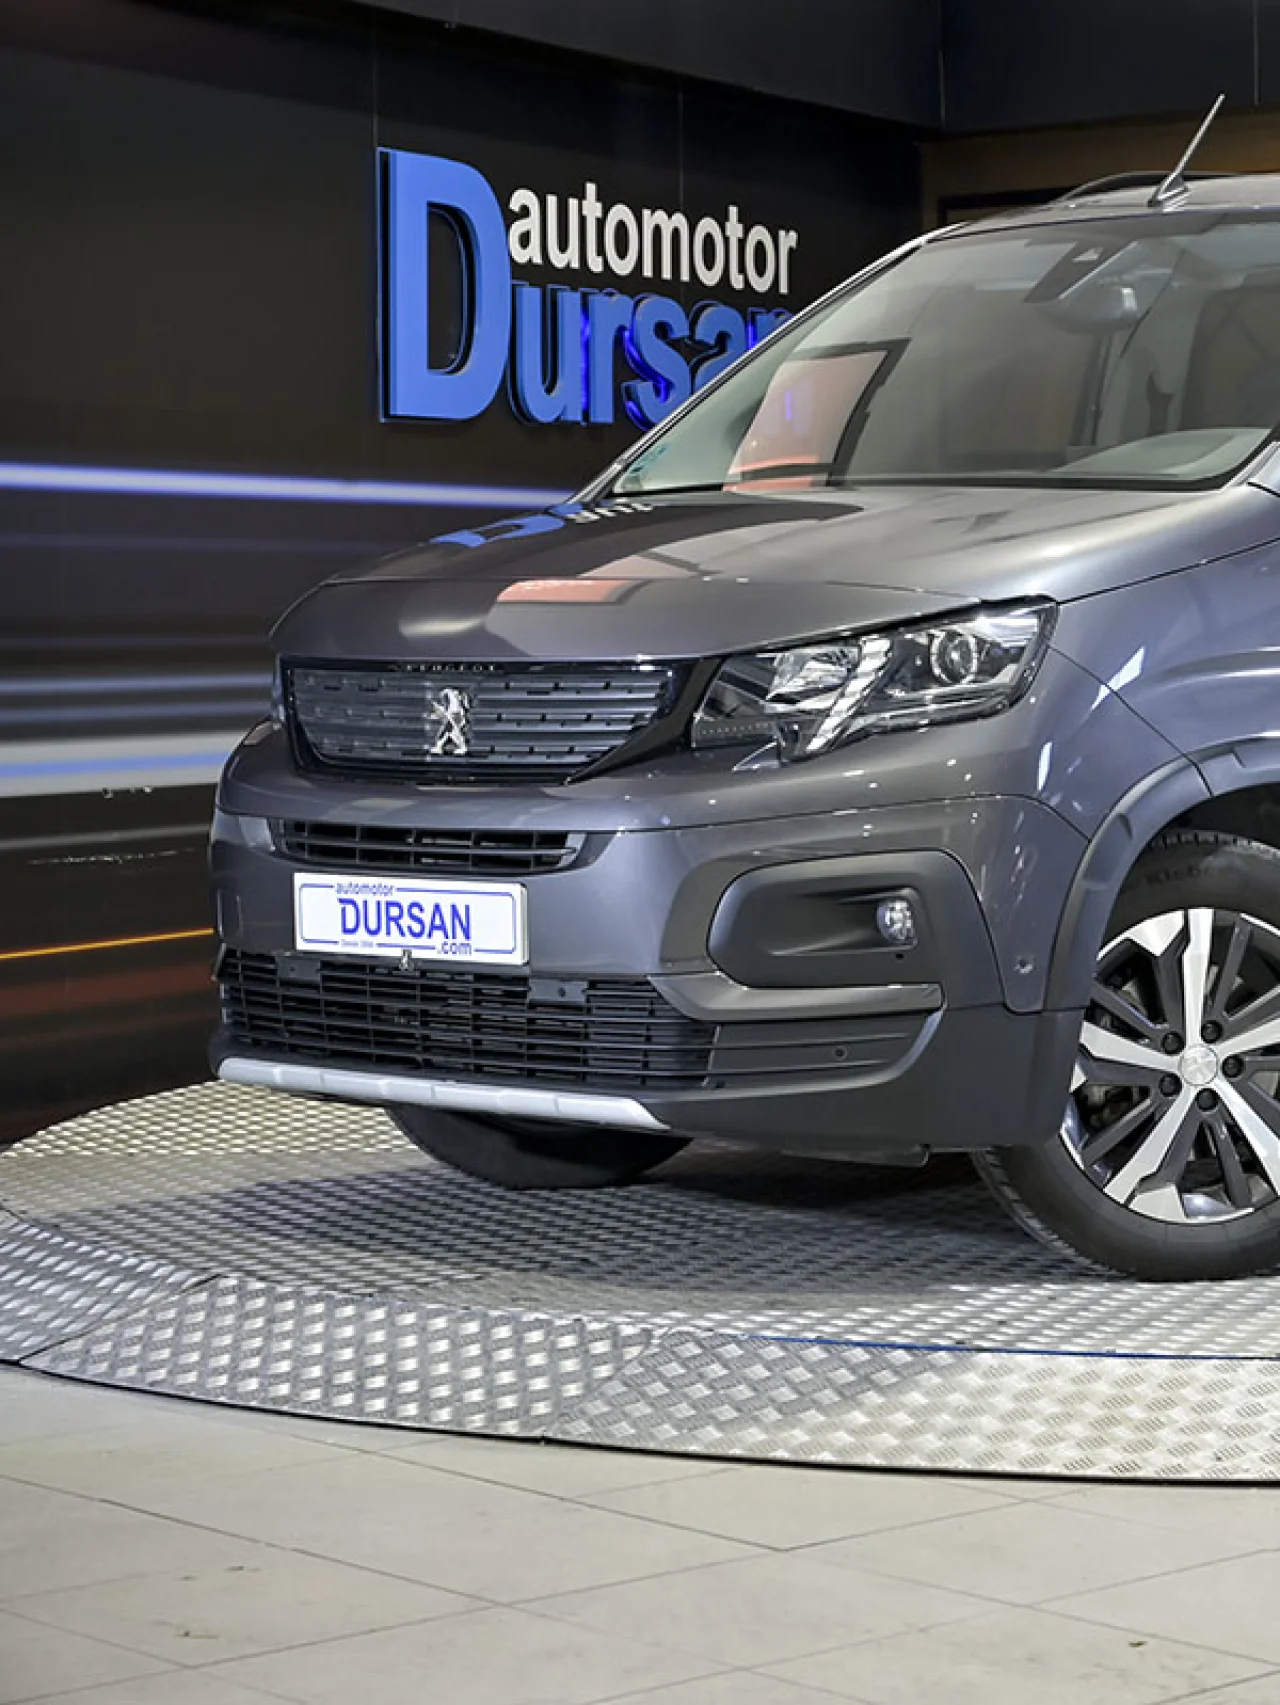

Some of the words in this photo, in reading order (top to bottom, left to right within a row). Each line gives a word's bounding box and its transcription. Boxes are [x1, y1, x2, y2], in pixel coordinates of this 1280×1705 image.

[509, 181, 798, 294] automotor
[337, 897, 472, 941] DURSAN
[437, 941, 473, 956] .com
